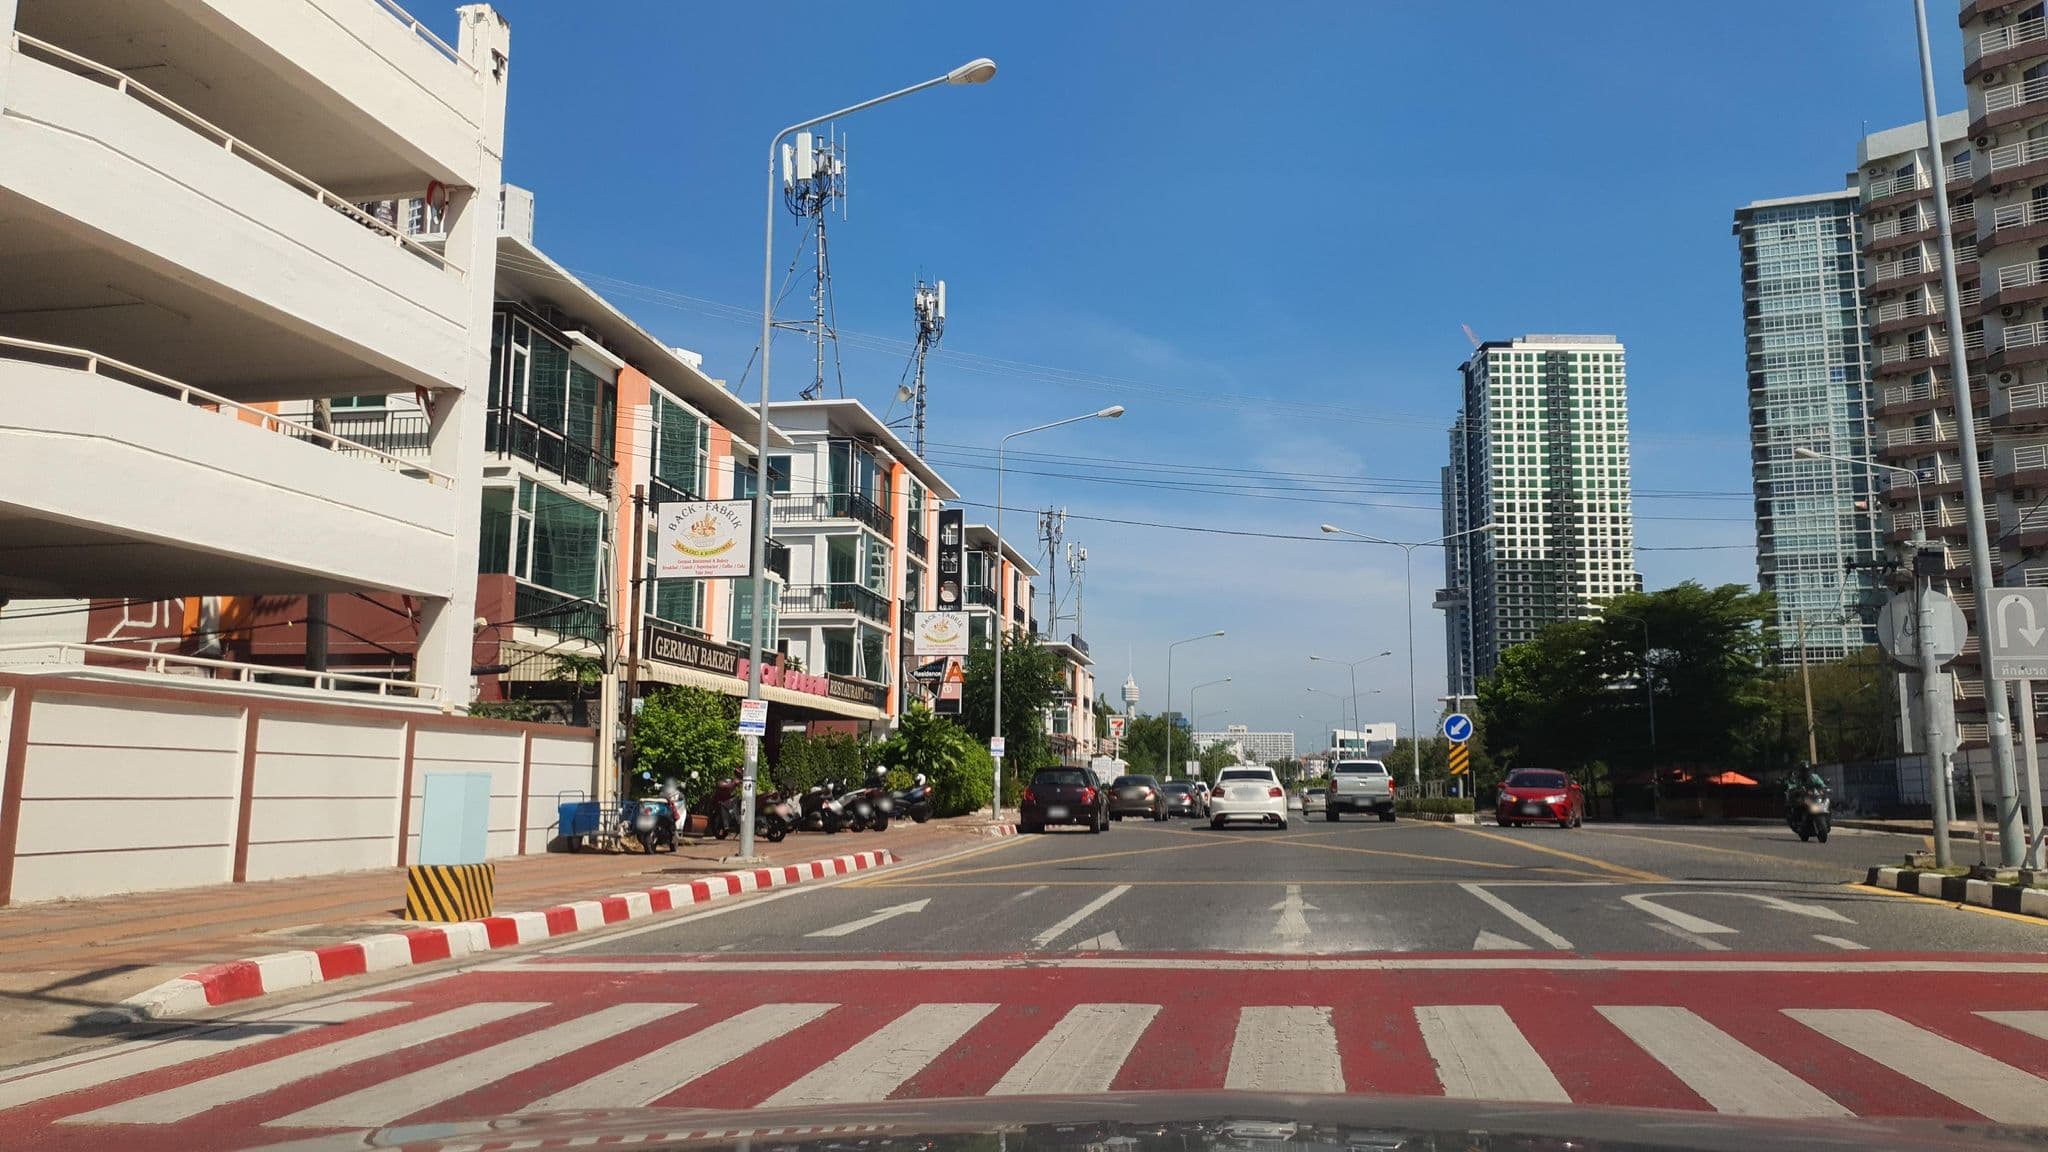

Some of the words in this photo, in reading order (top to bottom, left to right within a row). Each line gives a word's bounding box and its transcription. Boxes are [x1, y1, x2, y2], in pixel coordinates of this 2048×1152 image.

[668, 504, 696, 531] BACK
[705, 502, 742, 529] FABRIK
[655, 636, 698, 664] GERMAN
[700, 647, 736, 673] BAKERY
[829, 679, 865, 701] RESTAURANT
